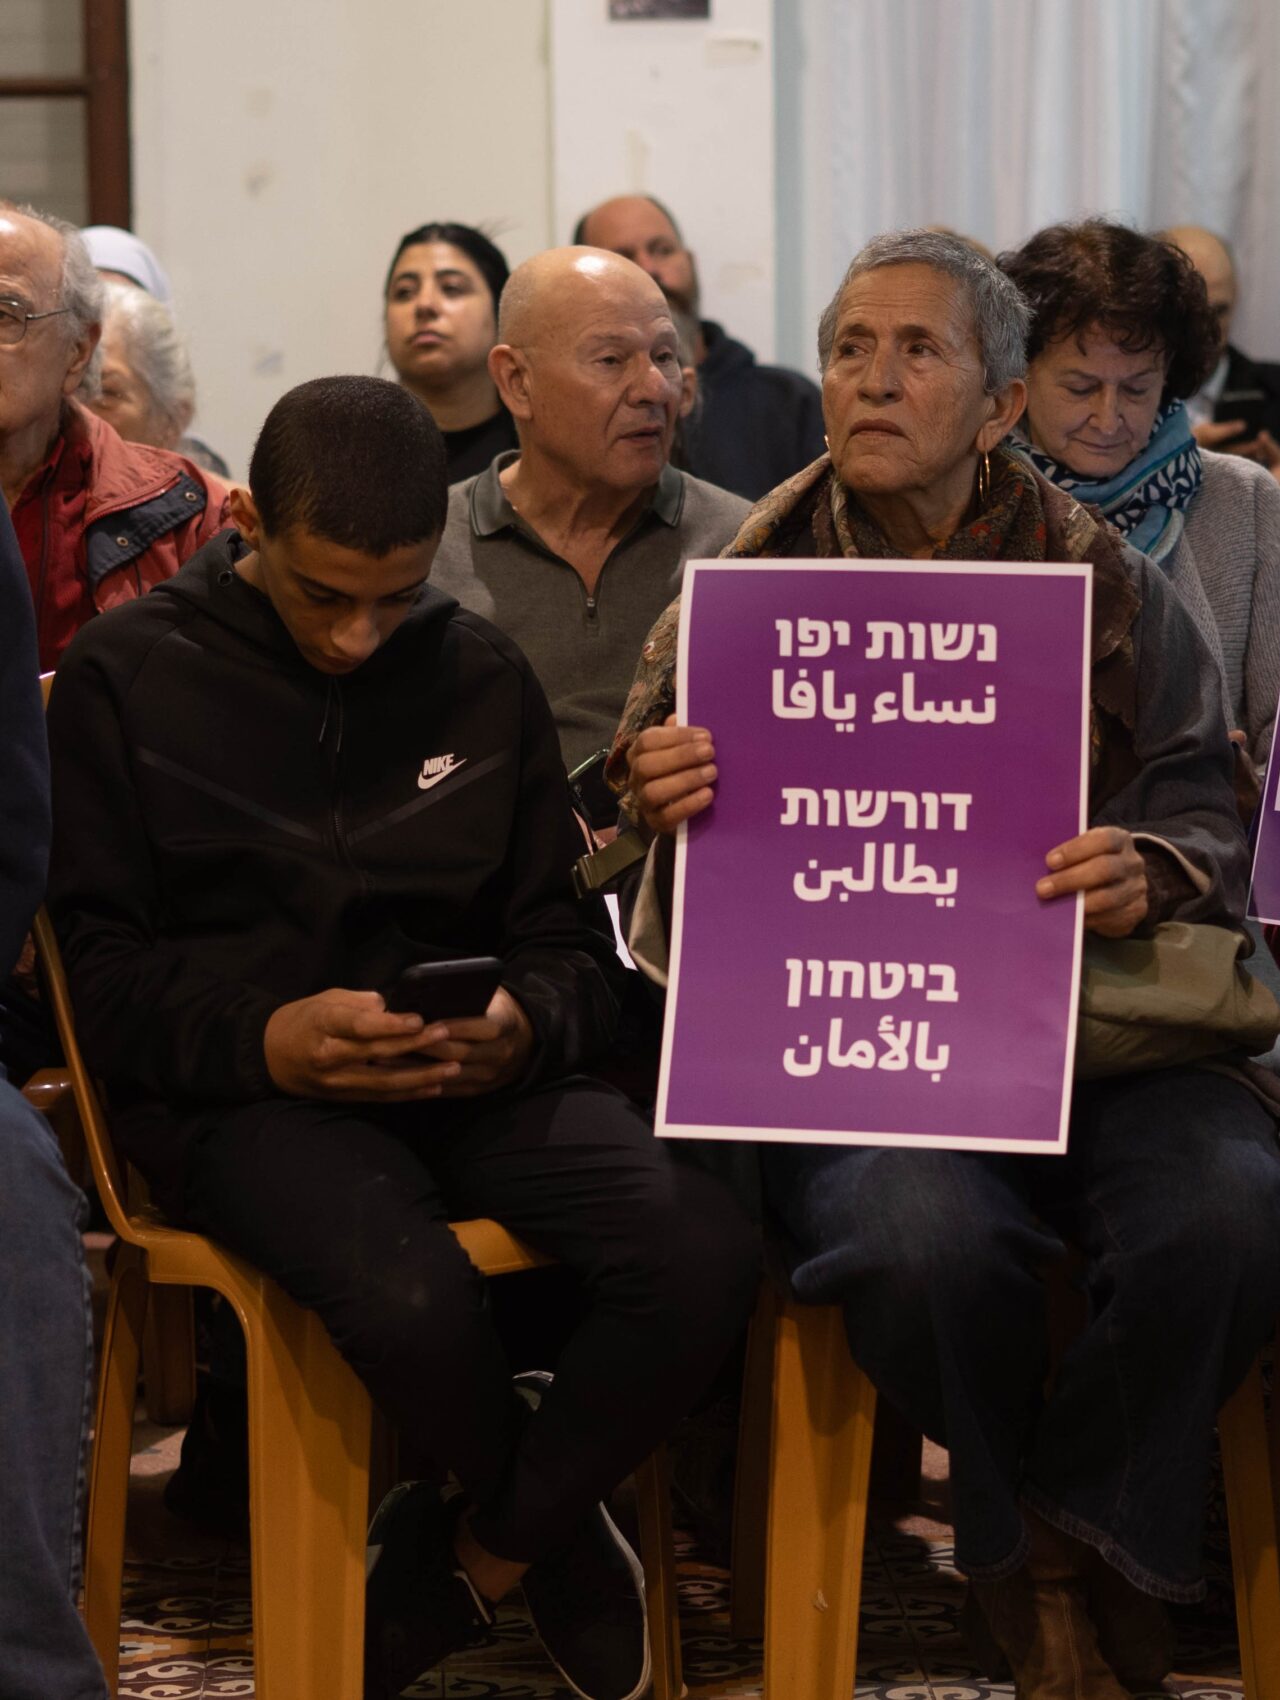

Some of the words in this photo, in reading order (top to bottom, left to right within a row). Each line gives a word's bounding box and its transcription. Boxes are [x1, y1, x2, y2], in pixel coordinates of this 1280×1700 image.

[775, 617, 850, 657] יפו
[865, 621, 997, 662] נשות
[772, 668, 857, 733] يافا
[871, 672, 997, 725] نساء
[423, 753, 455, 776] NIKE
[780, 787, 972, 831] דורשות
[793, 842, 958, 908] يطالبن
[785, 958, 959, 1008] ביטחון
[782, 1014, 950, 1083] بالأمان
